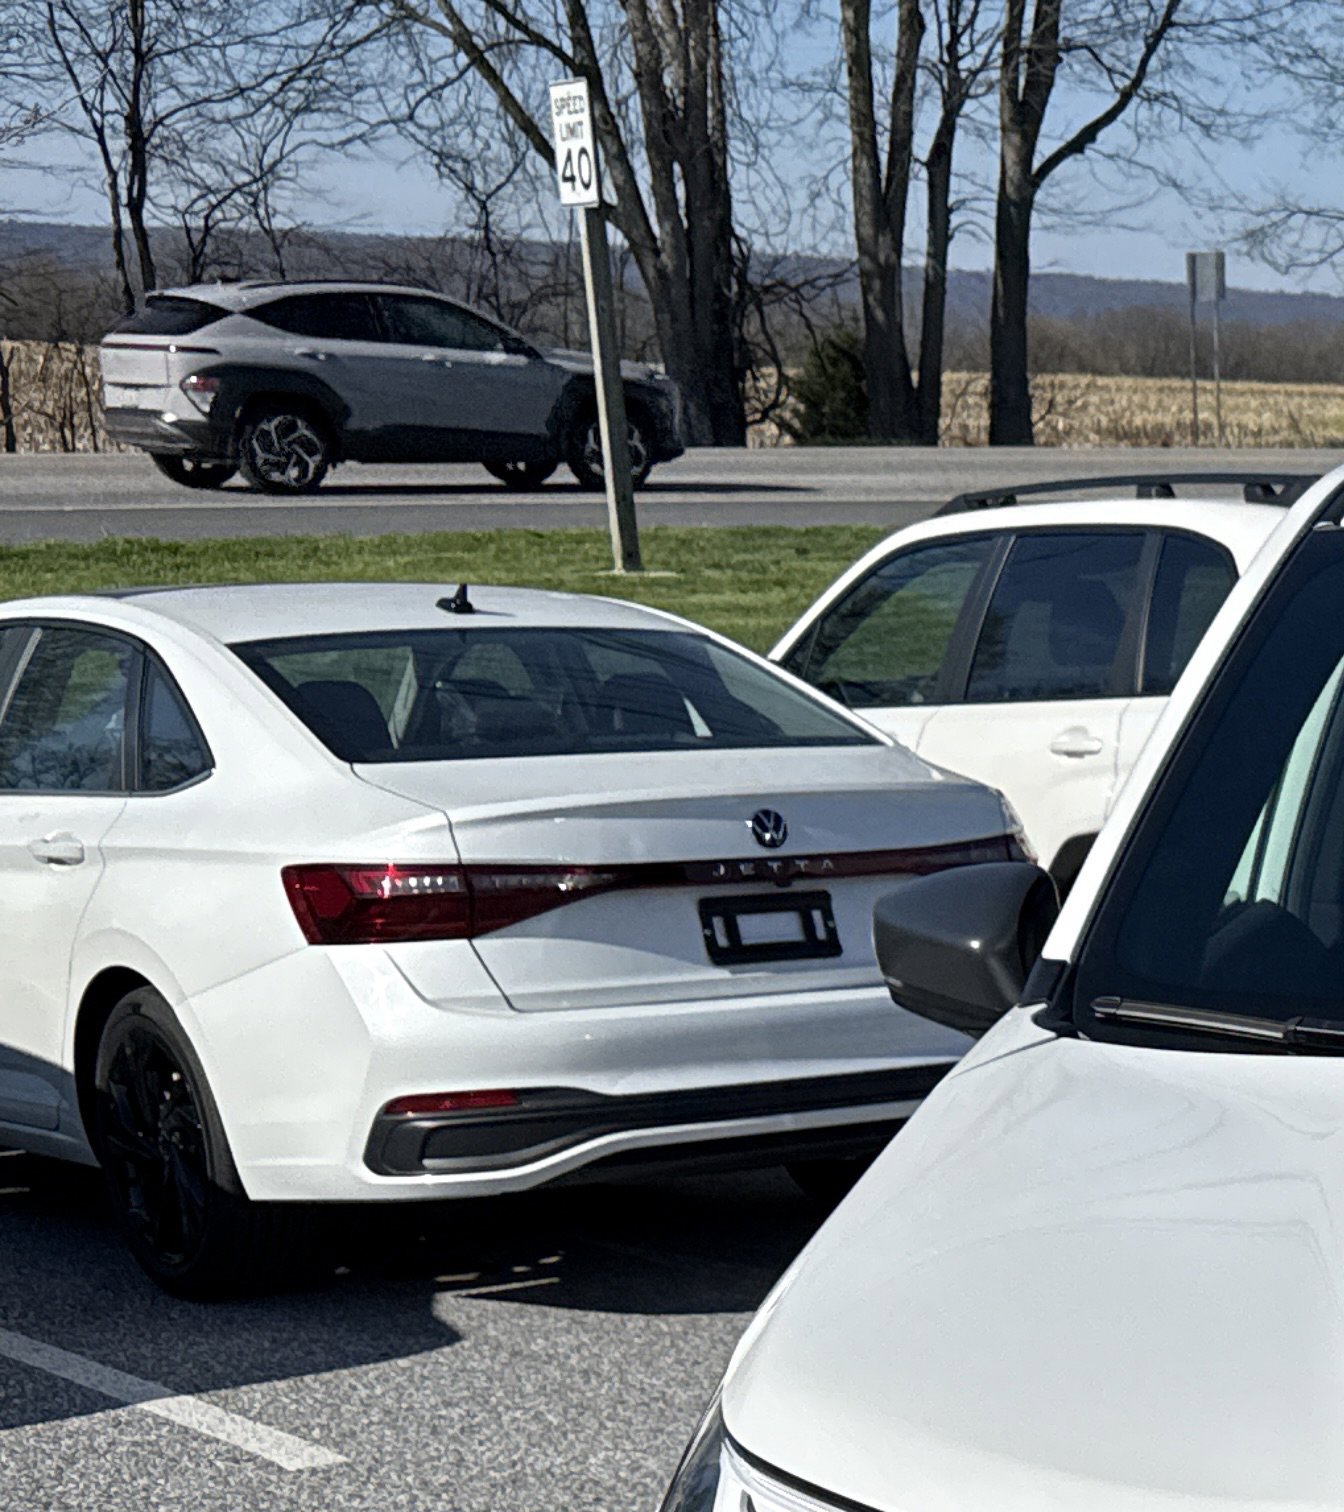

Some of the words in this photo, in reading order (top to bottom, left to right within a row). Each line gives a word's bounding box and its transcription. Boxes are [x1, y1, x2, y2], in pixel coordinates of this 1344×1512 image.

[553, 95, 586, 116] SPEED
[559, 121, 584, 142] LIMIT
[561, 146, 593, 192] 40
[712, 858, 834, 877] JETTA
